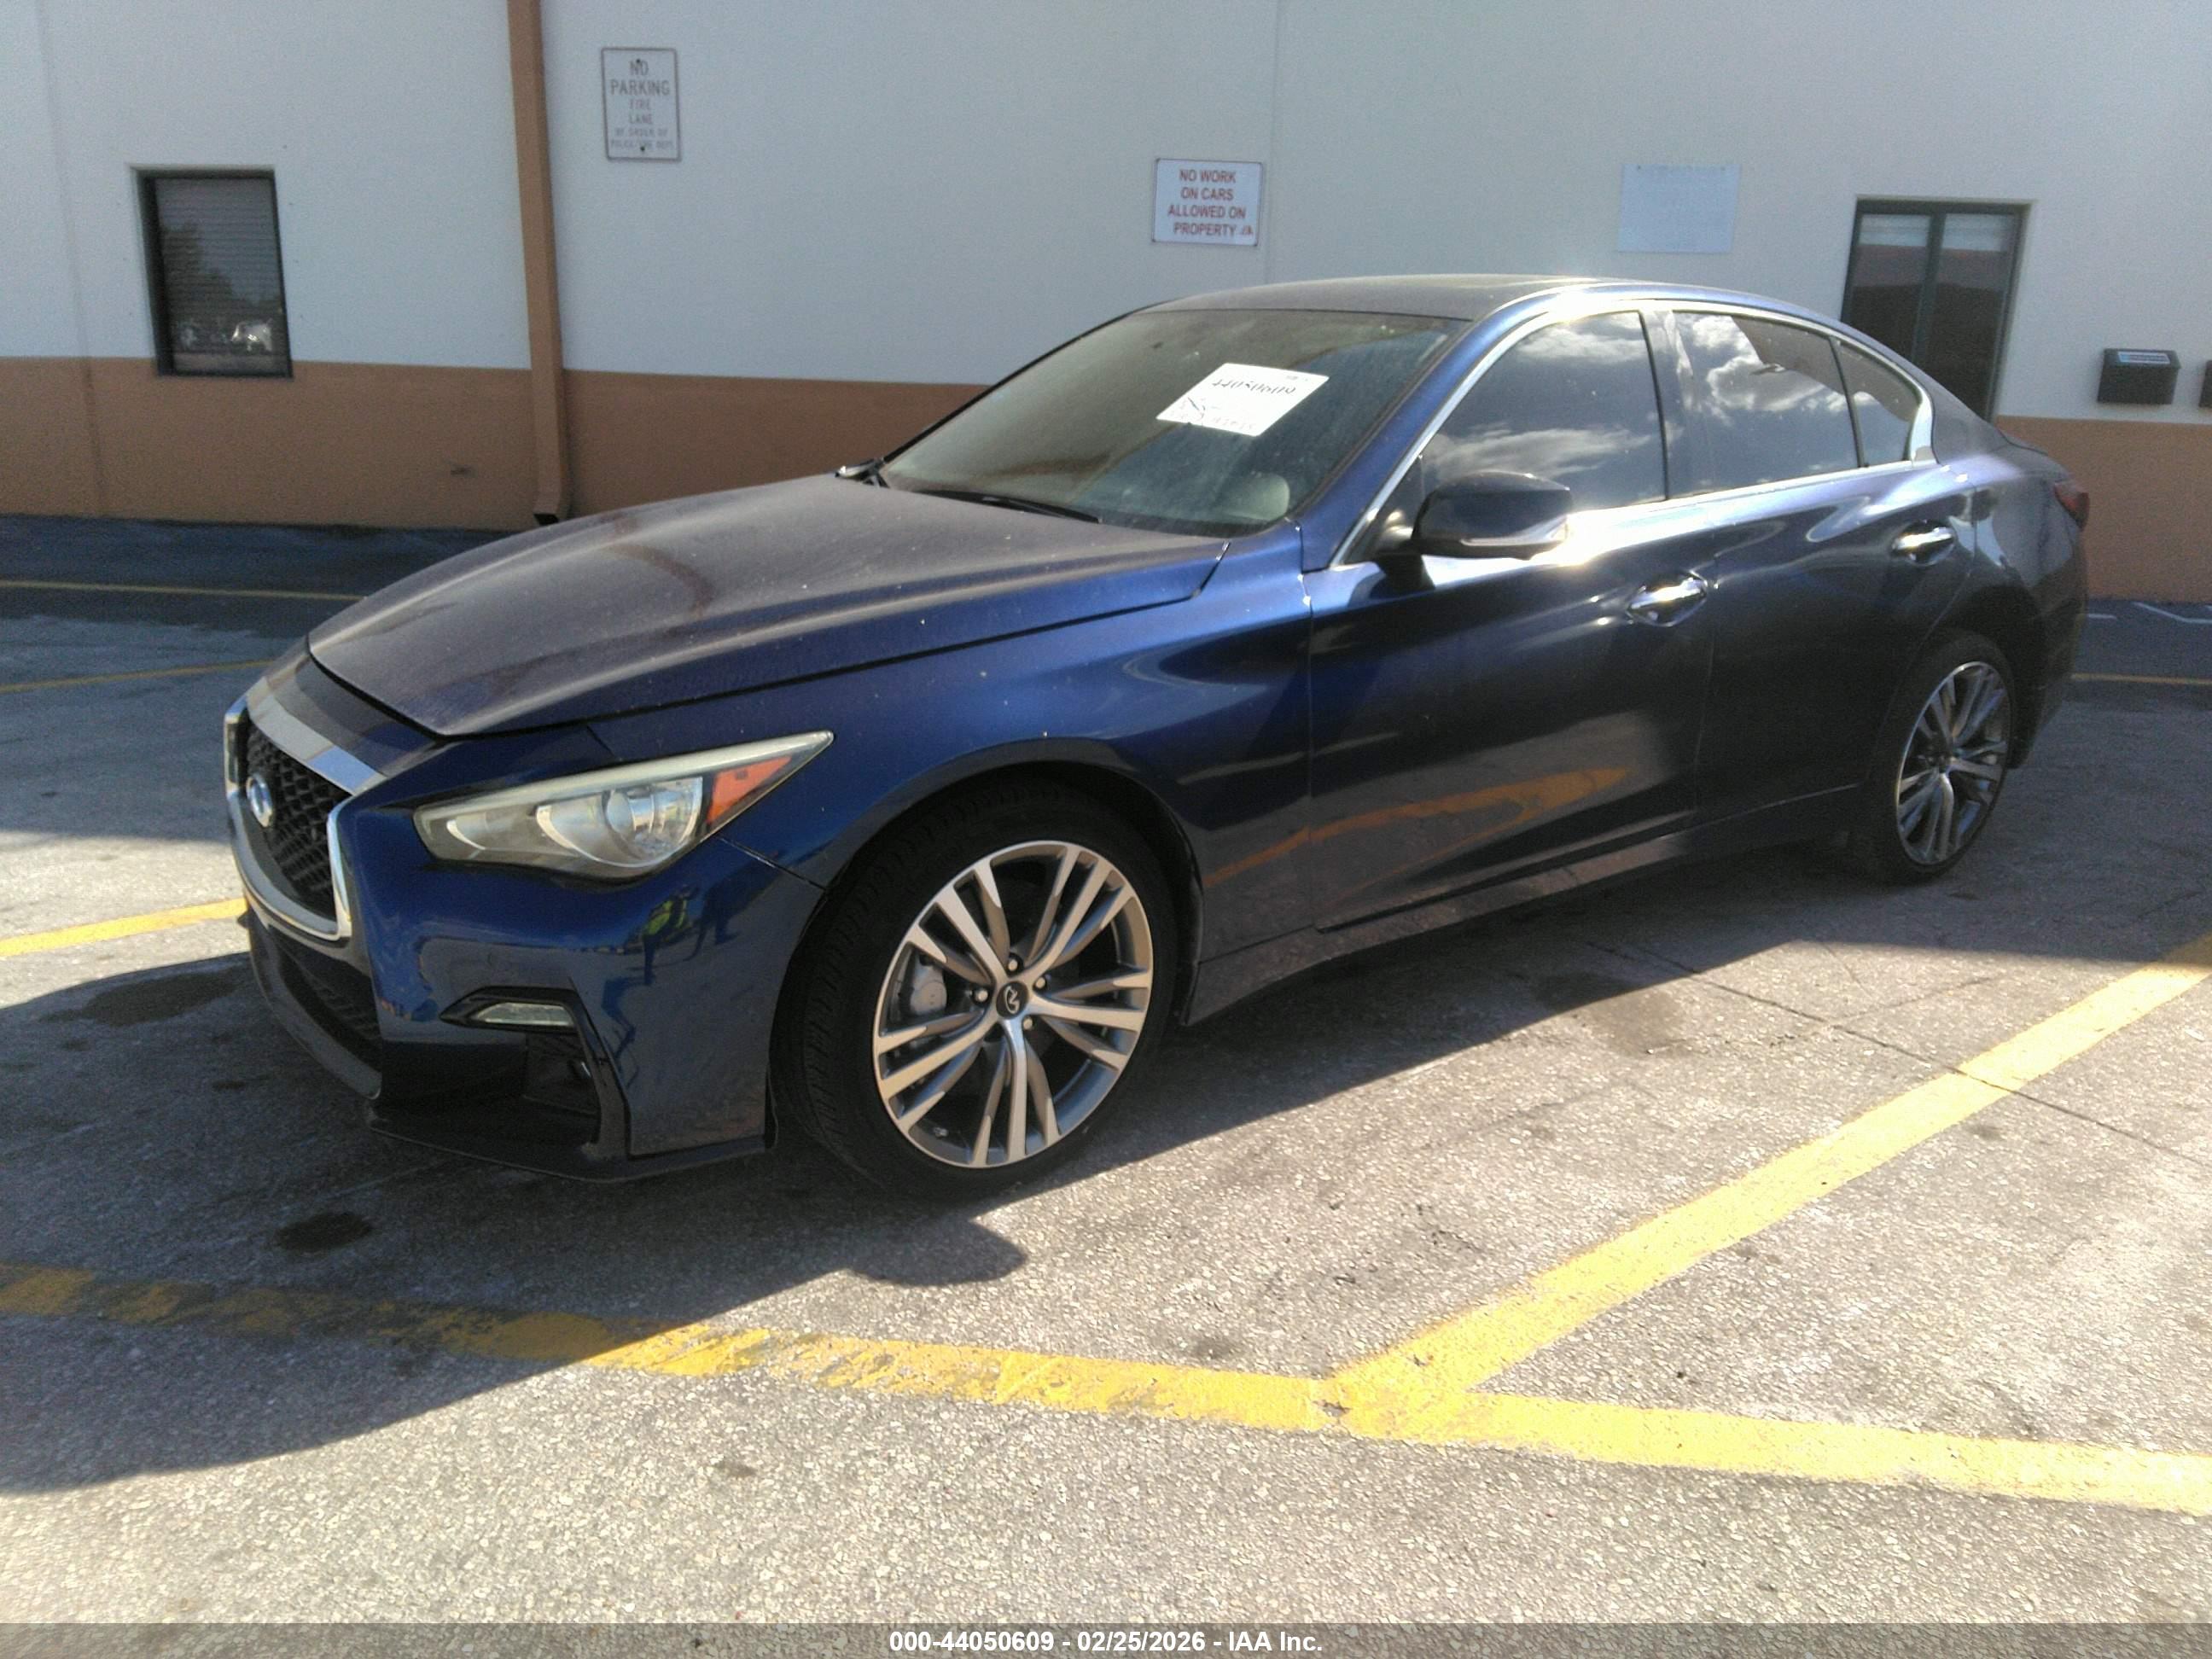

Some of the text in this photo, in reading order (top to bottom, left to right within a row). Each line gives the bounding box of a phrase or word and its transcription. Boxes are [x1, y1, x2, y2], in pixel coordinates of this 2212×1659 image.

[630, 59, 649, 76] NO
[610, 79, 670, 96] PARKING
[1179, 169, 1237, 183] NO WORK
[1180, 186, 1234, 201] ON CARS
[1168, 204, 1246, 219] ALLOWED ON
[1173, 222, 1237, 237] PROPERTY
